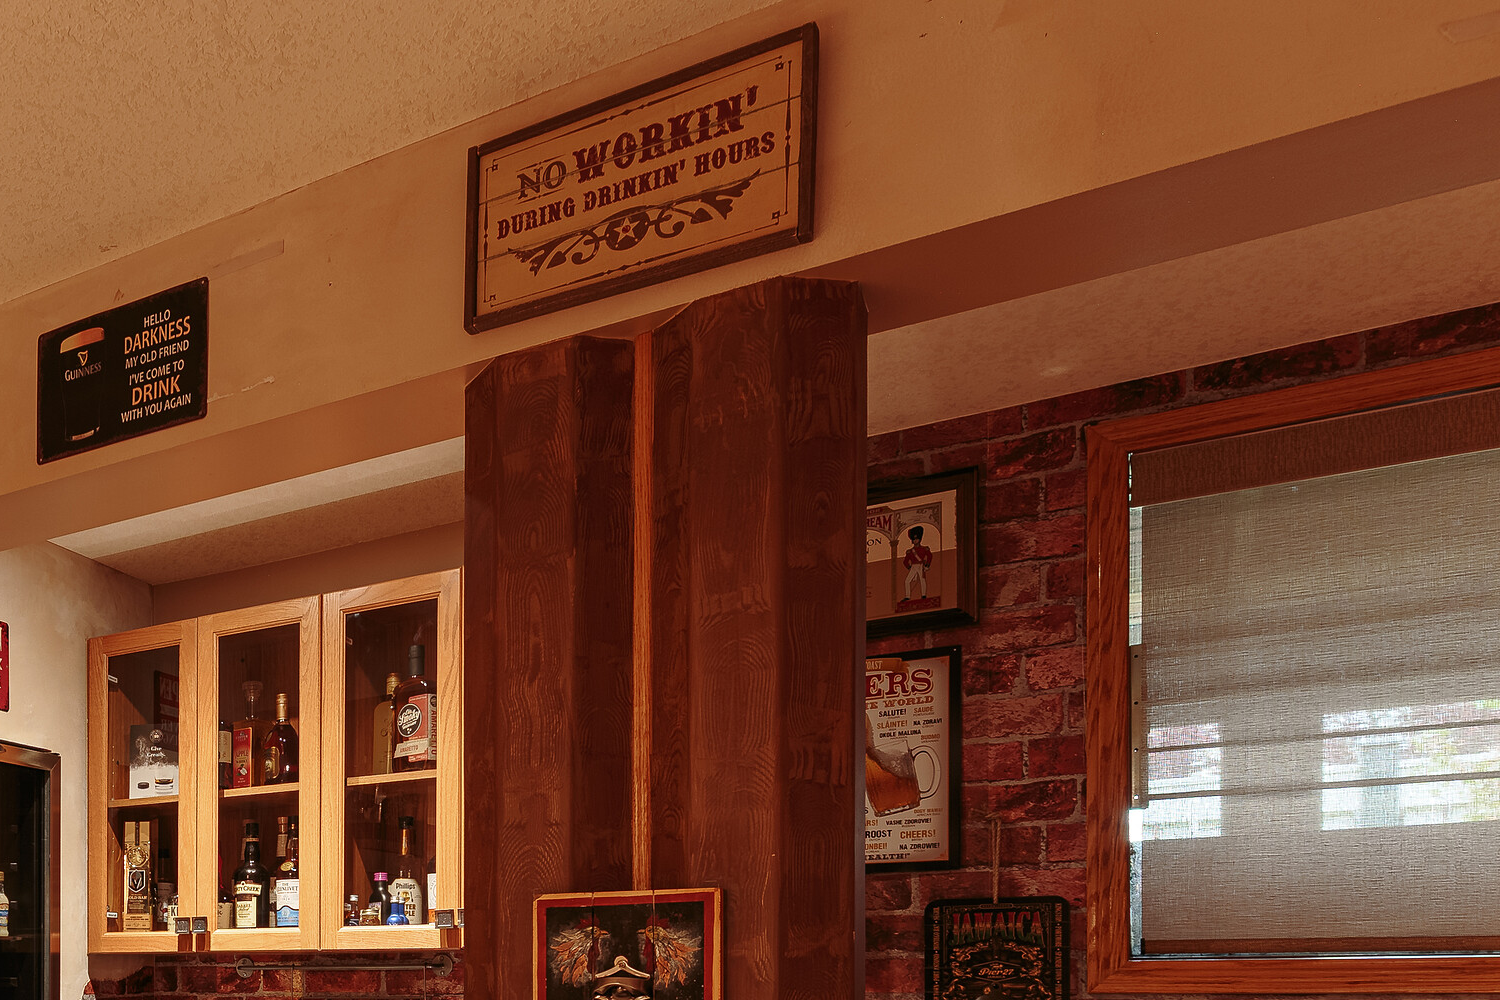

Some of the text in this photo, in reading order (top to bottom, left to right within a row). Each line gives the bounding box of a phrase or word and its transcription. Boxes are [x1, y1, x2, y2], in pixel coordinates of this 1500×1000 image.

[517, 85, 759, 200] NO WORKIN'
[497, 131, 776, 240] DURING DRINKIN' HOURS
[143, 309, 171, 328] HELLO
[124, 315, 191, 355] DARKNESS
[125, 339, 190, 370] MY OLD FRIEND
[64, 361, 102, 382] GUINNESS
[129, 359, 185, 386] I'VE COME TO
[131, 374, 181, 406] DRINK
[121, 392, 192, 423] WITH YOU AGAIN
[866, 669, 934, 700] ERS
[878, 708, 907, 718] SALUTE!
[883, 695, 934, 708] WORLD
[866, 829, 893, 839] ROOST
[900, 829, 936, 839] CHEERS!
[949, 911, 1046, 948] JAMAICA
